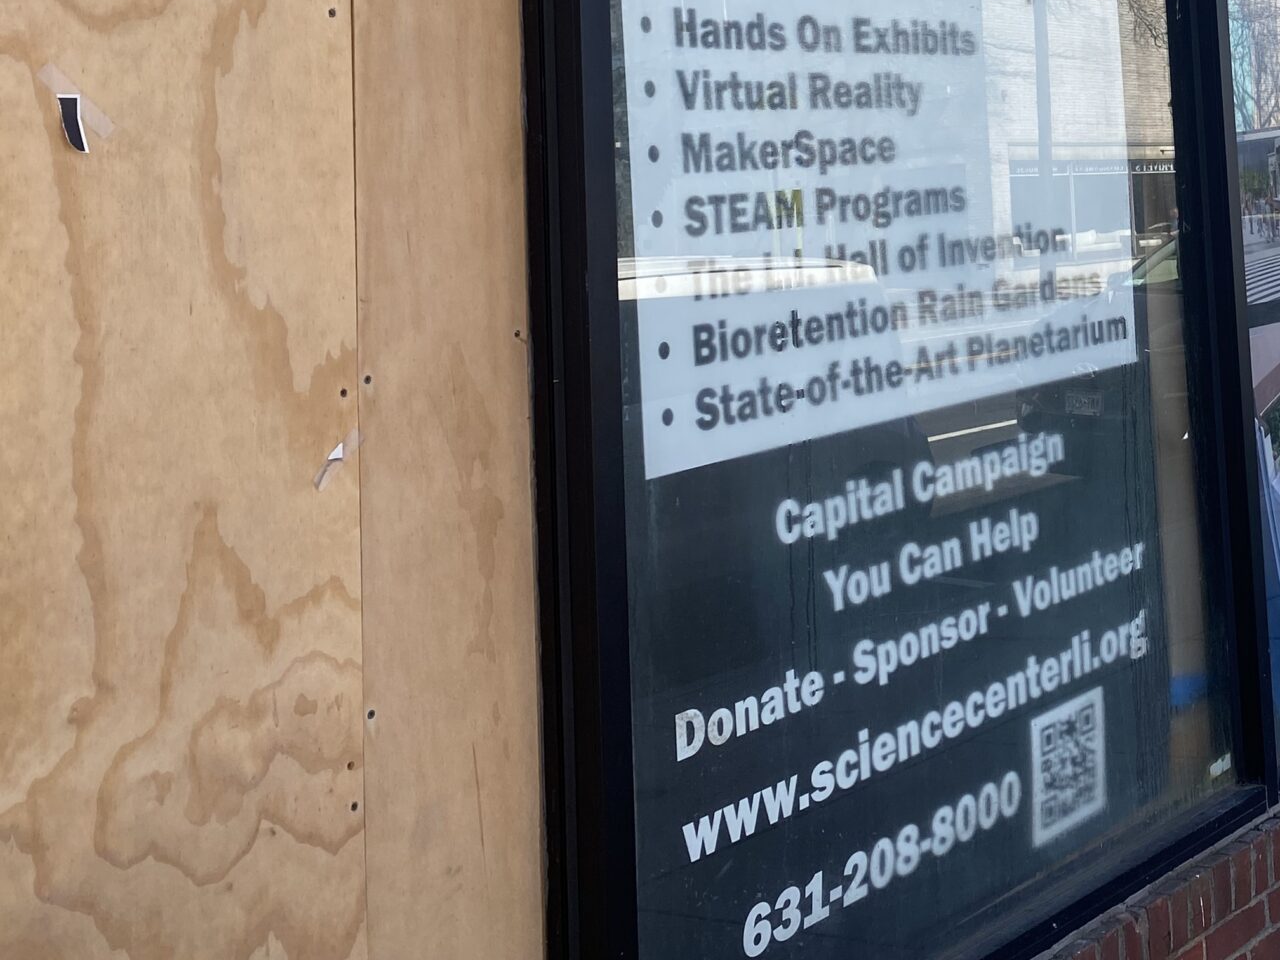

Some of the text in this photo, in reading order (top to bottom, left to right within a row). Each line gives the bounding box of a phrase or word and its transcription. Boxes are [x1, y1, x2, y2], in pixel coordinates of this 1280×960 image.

[673, 6, 977, 56] Hands On Exhibits
[676, 70, 923, 116] Virtual Reality
[681, 130, 896, 175] MakerSpace
[683, 182, 966, 237] STEAM Programs
[825, 239, 889, 283] Hall
[898, 232, 929, 273] of
[938, 221, 1071, 267] Invention
[692, 271, 1102, 367] Bioretention Rain Gardens
[695, 315, 1127, 432] State-of-the-Art Planetarium
[775, 429, 1065, 544] Capital Campaign
[823, 509, 1040, 612] You Can Help
[675, 667, 825, 762] Donate
[853, 601, 991, 686] Sponsor
[1012, 540, 1146, 618] Volunteer
[682, 610, 1148, 863] www.sciencecenterli.org
[741, 770, 1022, 959] 631-208-8000
